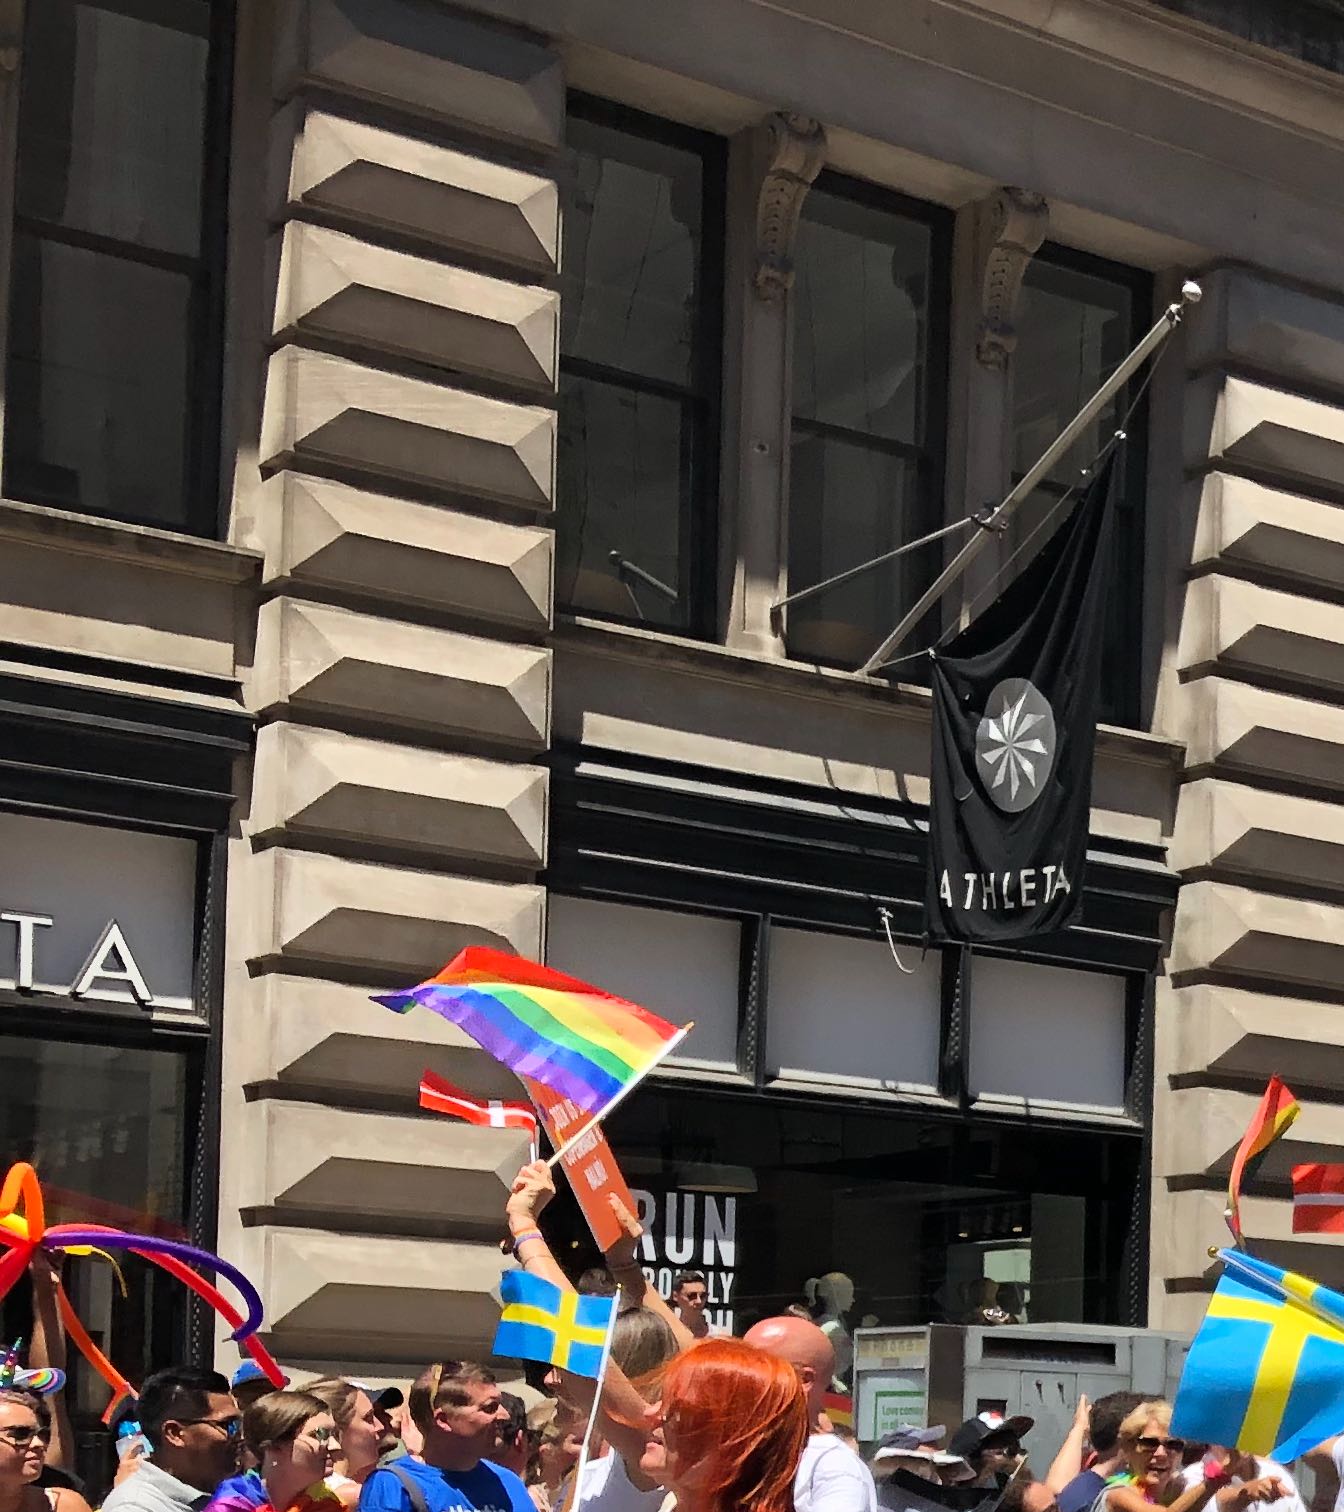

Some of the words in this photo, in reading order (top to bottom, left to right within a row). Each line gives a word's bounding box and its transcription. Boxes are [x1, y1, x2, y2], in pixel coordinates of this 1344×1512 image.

[940, 861, 1071, 910] ATHLETA
[0, 912, 153, 1001] TA
[631, 1188, 737, 1268] RUN
